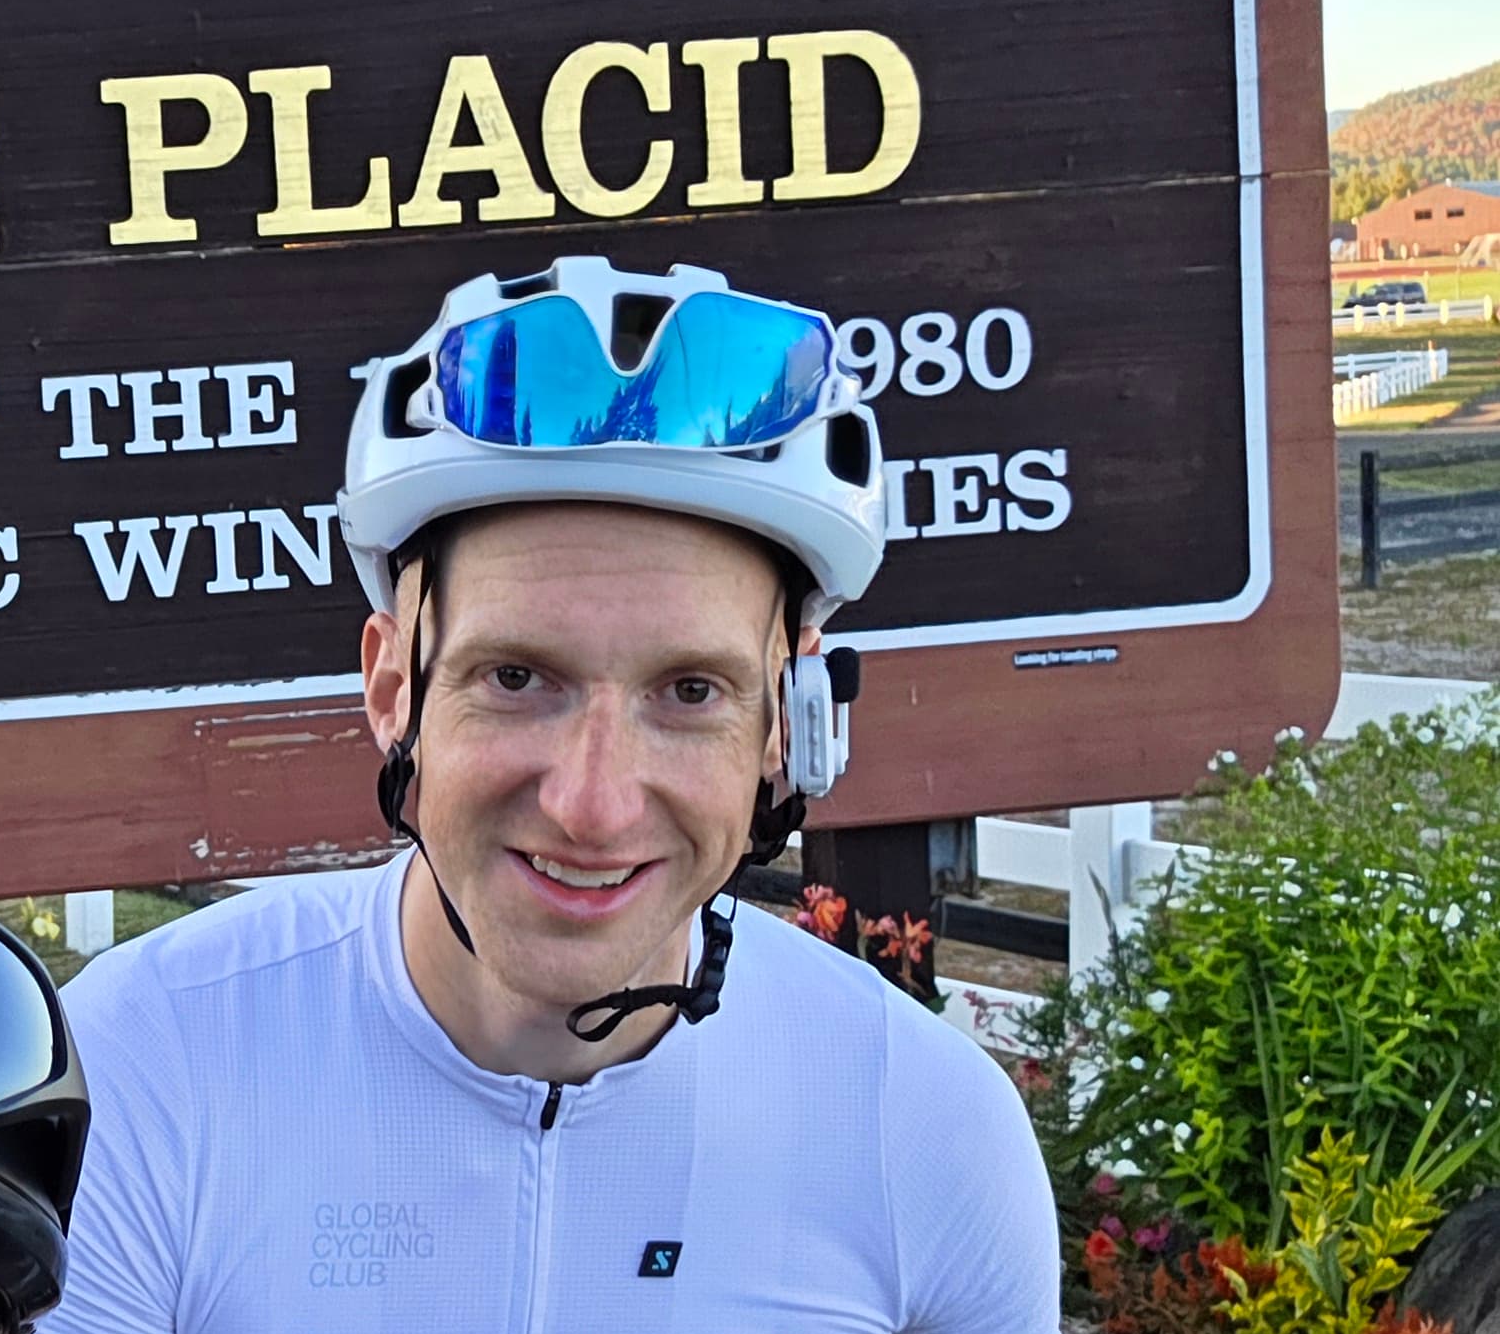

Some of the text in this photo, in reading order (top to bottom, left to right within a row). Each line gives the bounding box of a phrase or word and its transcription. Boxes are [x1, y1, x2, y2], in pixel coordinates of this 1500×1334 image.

[100, 29, 921, 246] PLACID
[41, 360, 298, 460] THE
[73, 503, 339, 603] WIN
[312, 1232, 435, 1259] CYCLING
[315, 1203, 428, 1229] GLOBAL
[309, 1261, 387, 1288] CLUB
